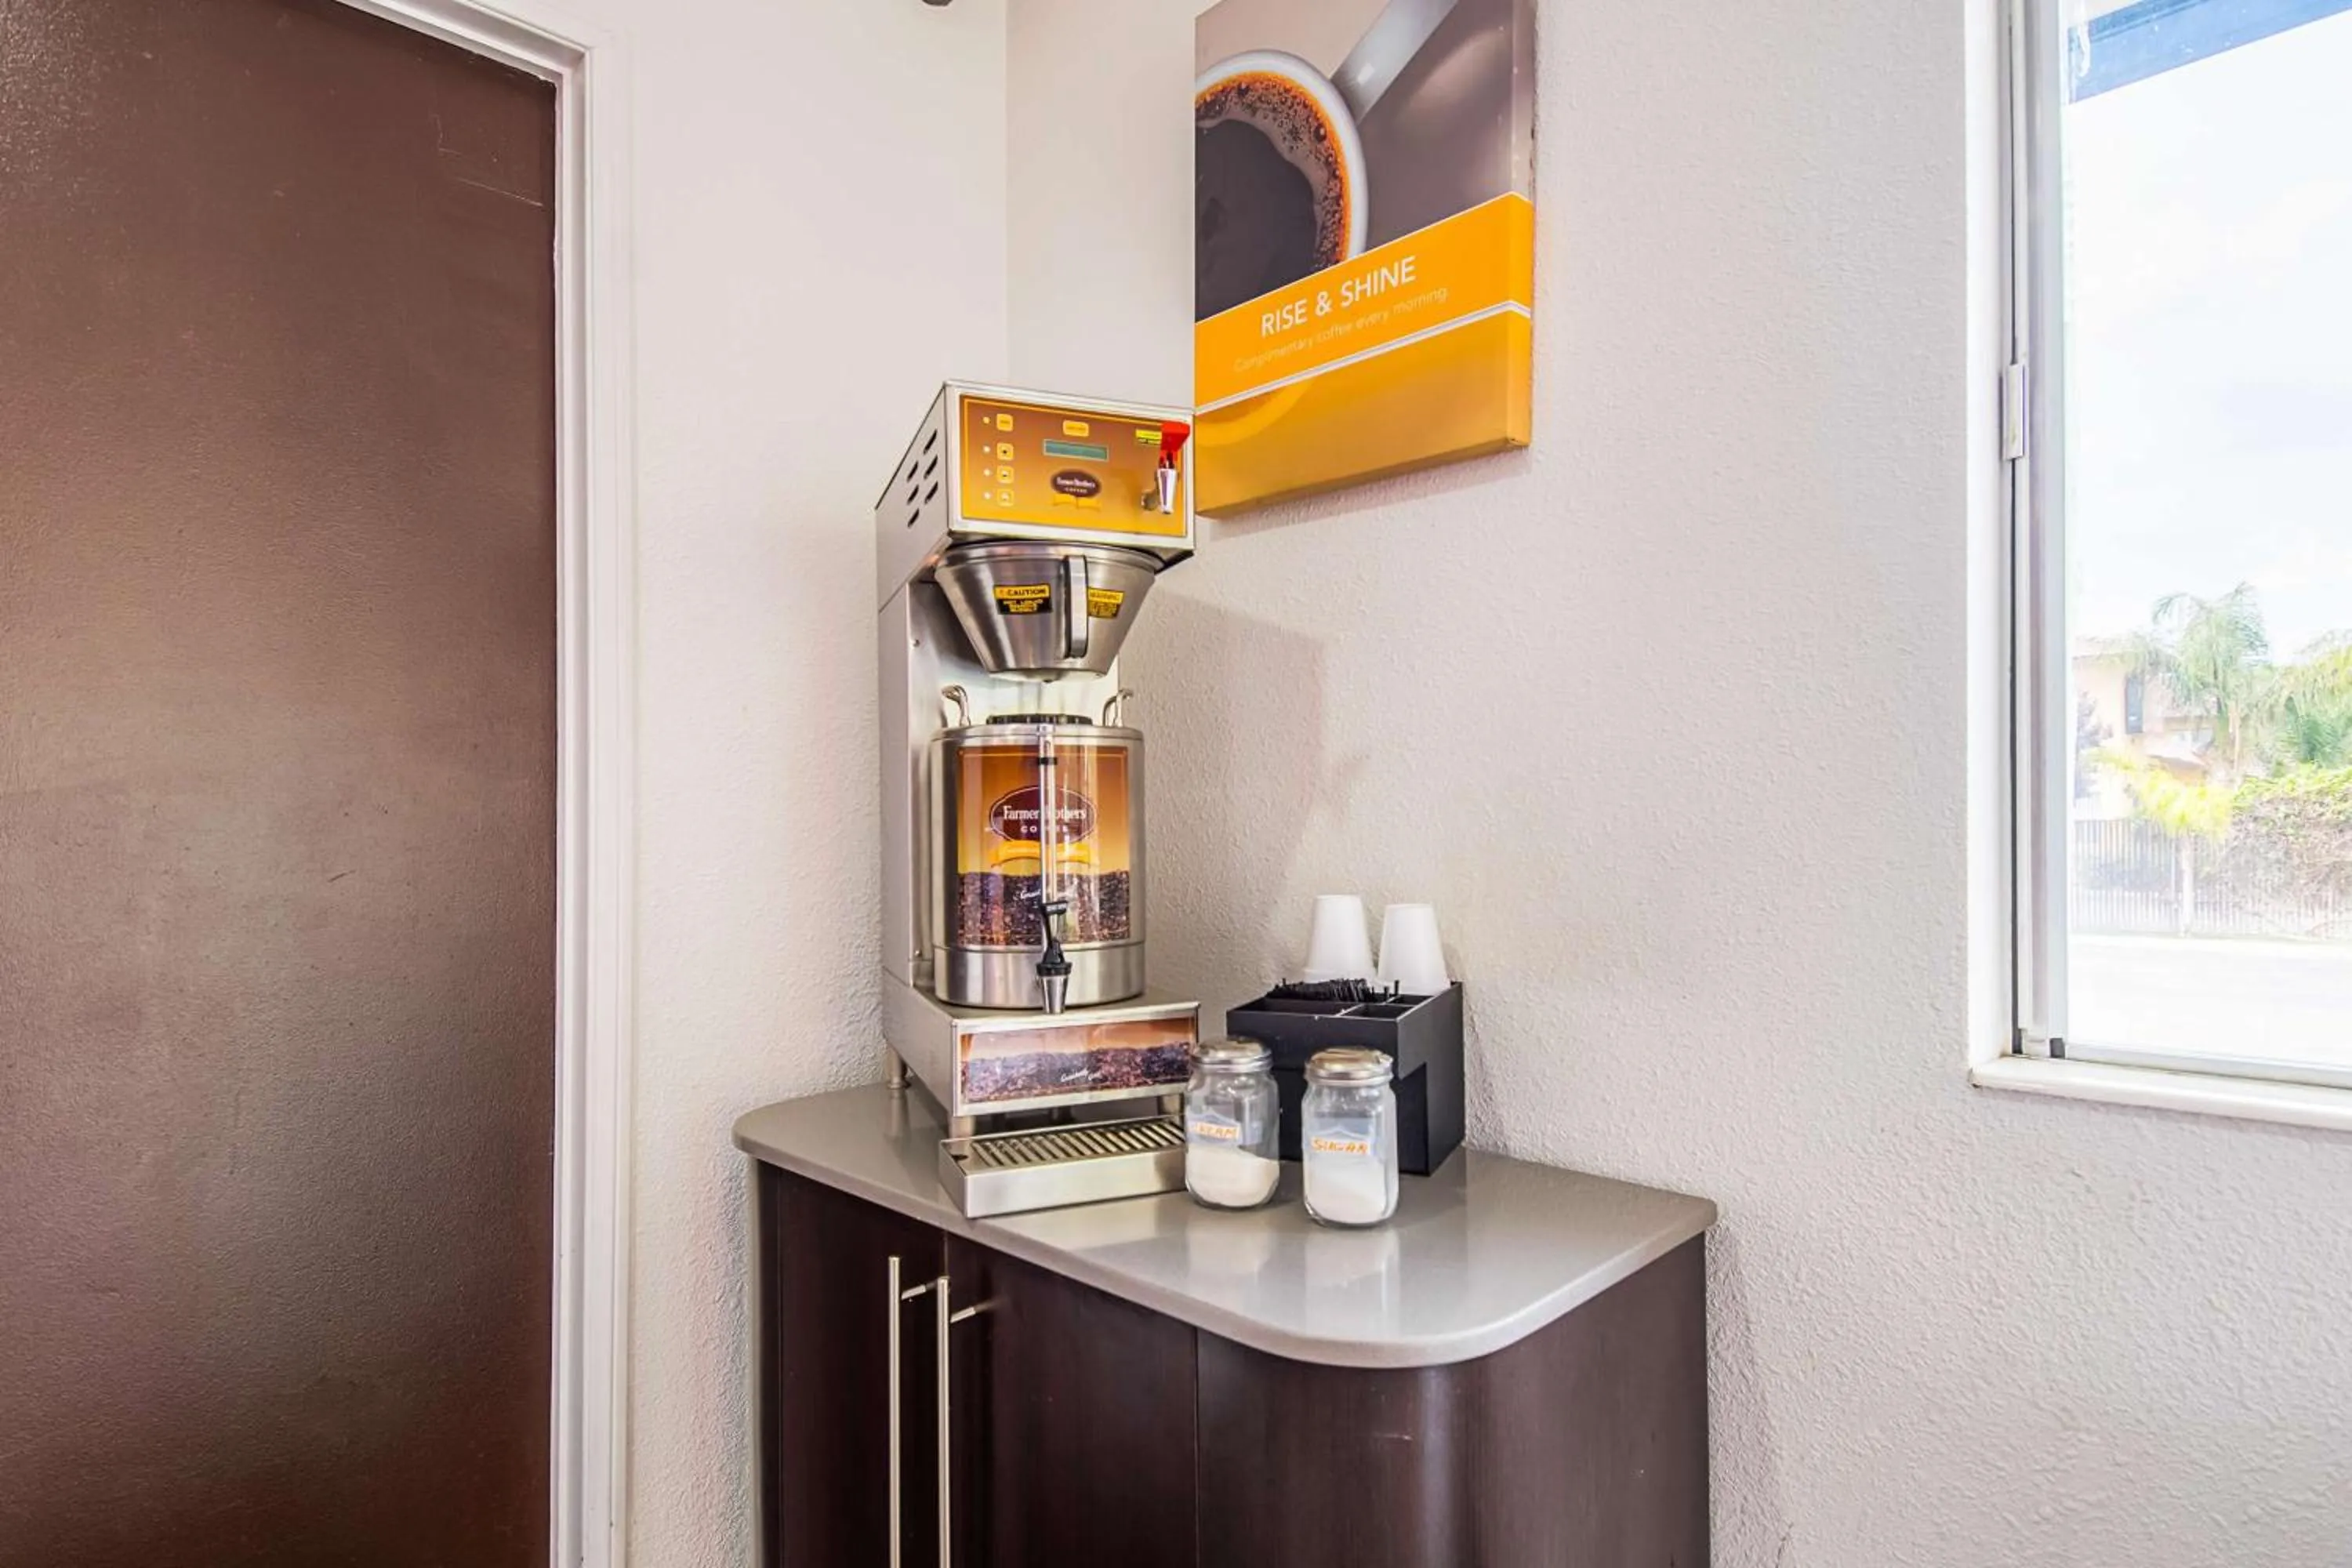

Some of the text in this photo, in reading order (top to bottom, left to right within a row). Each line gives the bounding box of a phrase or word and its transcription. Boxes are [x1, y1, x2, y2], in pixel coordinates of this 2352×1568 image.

[1261, 255, 1417, 339] RISE & SHINE
[1316, 322, 1353, 342] coffee
[1355, 310, 1389, 330] every
[1007, 588, 1046, 597] CAUTION
[1003, 805, 1087, 821] Farmer others
